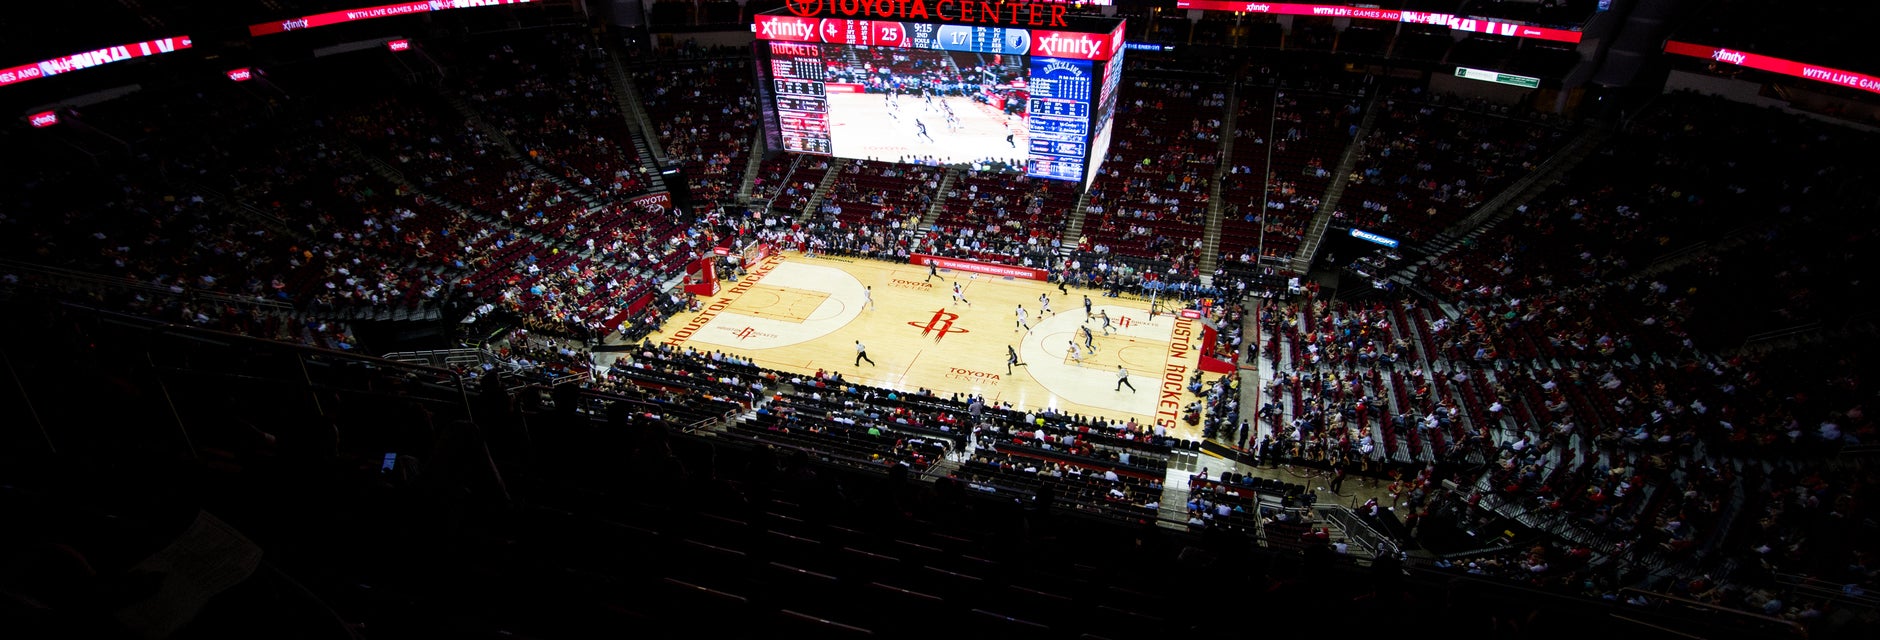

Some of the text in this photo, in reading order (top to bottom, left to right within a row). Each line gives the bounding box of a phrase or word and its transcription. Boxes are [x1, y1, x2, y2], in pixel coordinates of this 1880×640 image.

[283, 19, 309, 31] xfinity
[347, 11, 369, 20] WITH
[369, 8, 386, 16] LIVE
[387, 5, 412, 15] GAMES
[413, 3, 429, 11] AND
[936, 0, 1068, 27] CENTER
[1246, 3, 1270, 13] xfinity
[1313, 7, 1334, 15] WITH
[1334, 8, 1352, 16] LIVE
[1353, 10, 1380, 18] GAMES
[1381, 12, 1399, 20] AND
[881, 28, 898, 41] 25
[914, 23, 932, 33] 9:15
[950, 32, 968, 45] 17
[771, 42, 819, 57] ROCKETS
[18, 67, 40, 80] AND
[1712, 49, 1746, 65] xfinity
[1802, 67, 1831, 81] WITH
[1831, 73, 1858, 86] LIVE
[633, 194, 669, 208] TOYOTA
[892, 278, 933, 288] TOYOTA
[664, 255, 786, 347] HOUSTON ROCKETS
[949, 367, 1000, 380] TOYOTA
[1158, 317, 1193, 429] USTON ROCKETS
